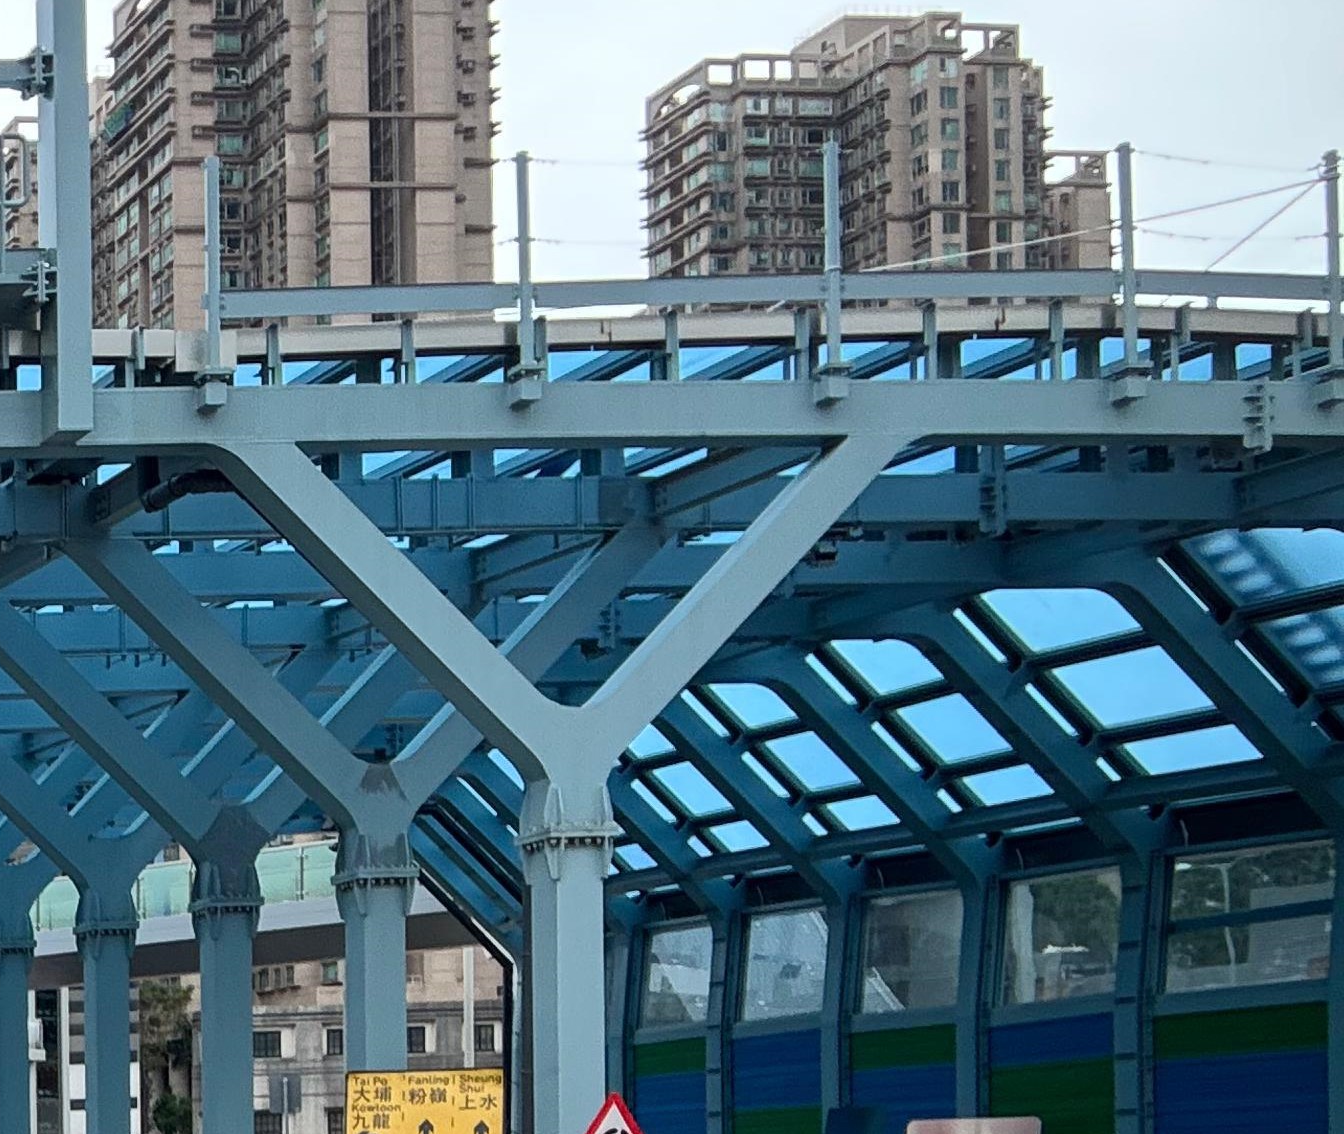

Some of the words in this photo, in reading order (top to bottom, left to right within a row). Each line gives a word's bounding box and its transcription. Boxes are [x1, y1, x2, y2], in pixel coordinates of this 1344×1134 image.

[353, 1076, 370, 1085] Tai
[373, 1077, 388, 1086] Po
[408, 1075, 450, 1086] Fanling
[459, 1074, 502, 1084] Sheung
[353, 1086, 392, 1103] 大埔
[459, 1085, 485, 1093] Shui
[408, 1088, 448, 1105] 粉嶺
[351, 1103, 401, 1112] Kowloon
[459, 1094, 498, 1111] 上水
[352, 1113, 391, 1130] 九龍
